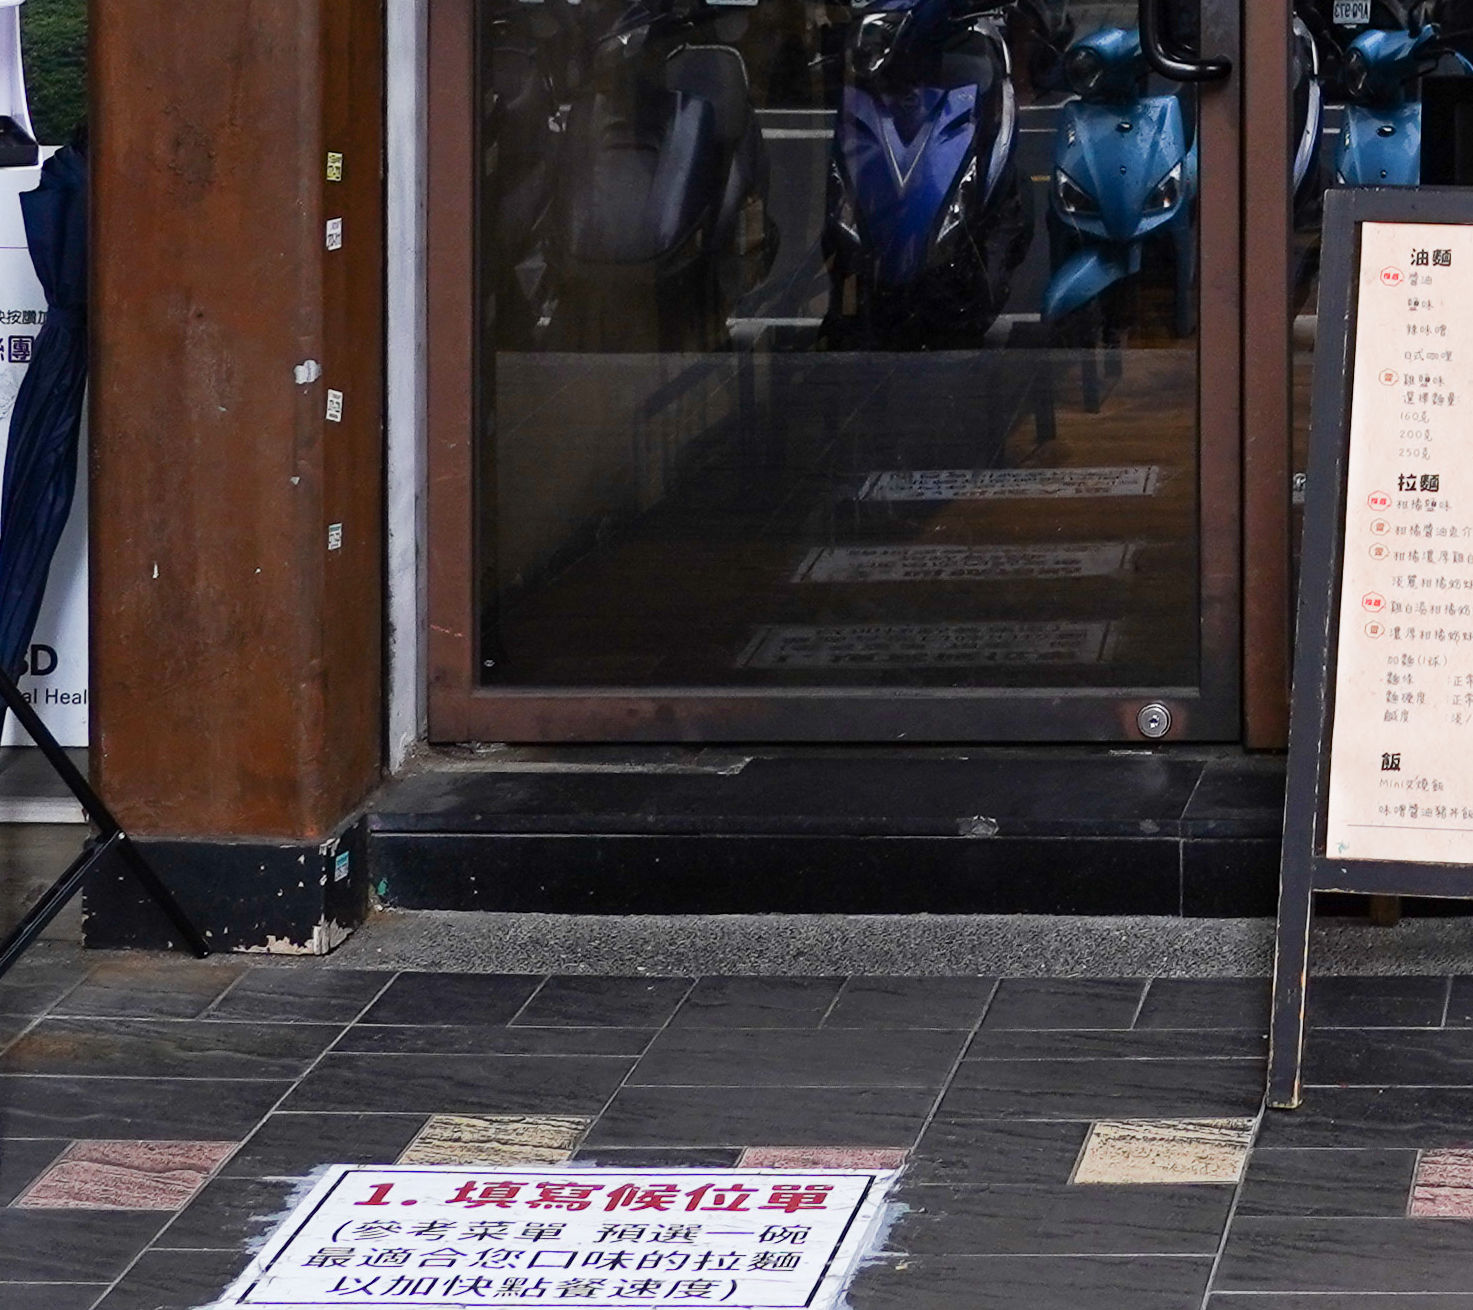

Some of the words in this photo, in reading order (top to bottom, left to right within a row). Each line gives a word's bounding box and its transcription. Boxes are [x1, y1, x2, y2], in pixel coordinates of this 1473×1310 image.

[1410, 248, 1452, 266] 油麵
[1398, 474, 1439, 492] 拉麵
[1381, 753, 1401, 771] 飯
[452, 1182, 831, 1212] 填寫候位單
[300, 1247, 803, 1272] 最適合您口味的拉麵
[327, 1275, 739, 1301] 以加快點餐速度)
